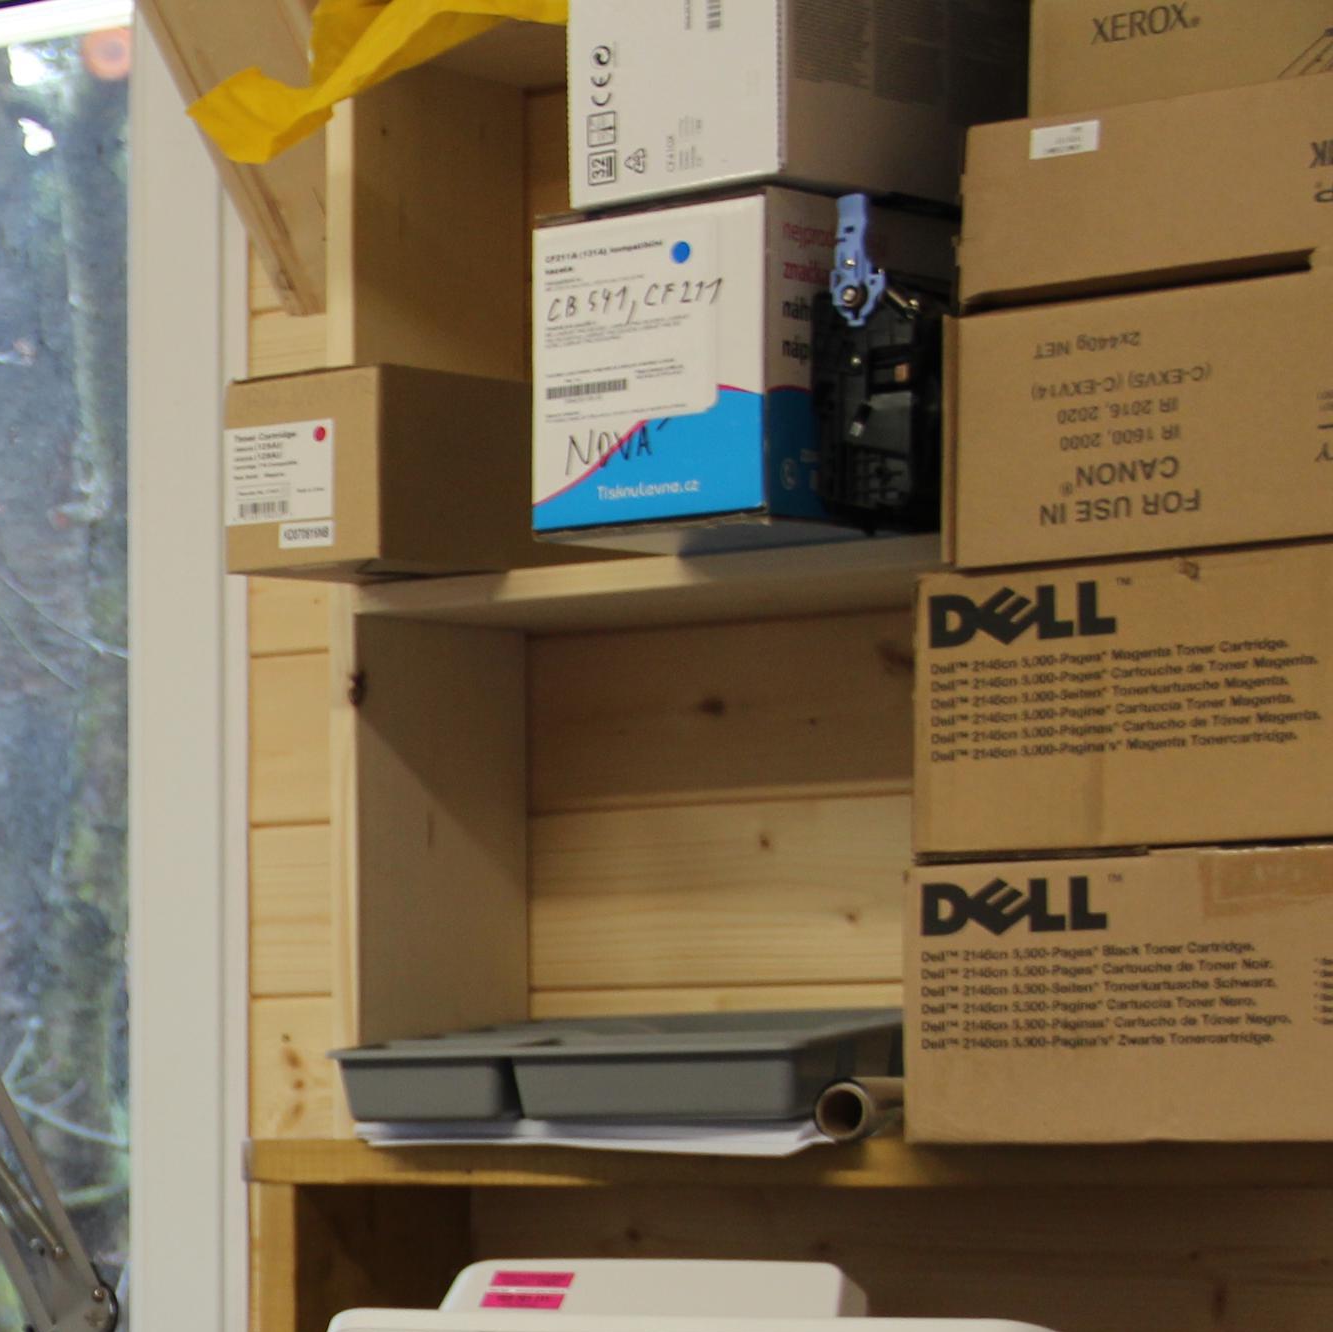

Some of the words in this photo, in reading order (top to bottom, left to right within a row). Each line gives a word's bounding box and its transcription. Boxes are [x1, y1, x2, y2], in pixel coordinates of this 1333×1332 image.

[1034, 340, 1072, 359] NET
[1039, 502, 1068, 526] IN
[1075, 495, 1132, 523] USE
[1142, 488, 1202, 516] FOR
[928, 581, 1117, 649] DELL
[1177, 643, 1215, 656] Toner
[920, 875, 1107, 936] DELL
[1144, 942, 1183, 955] Toner
